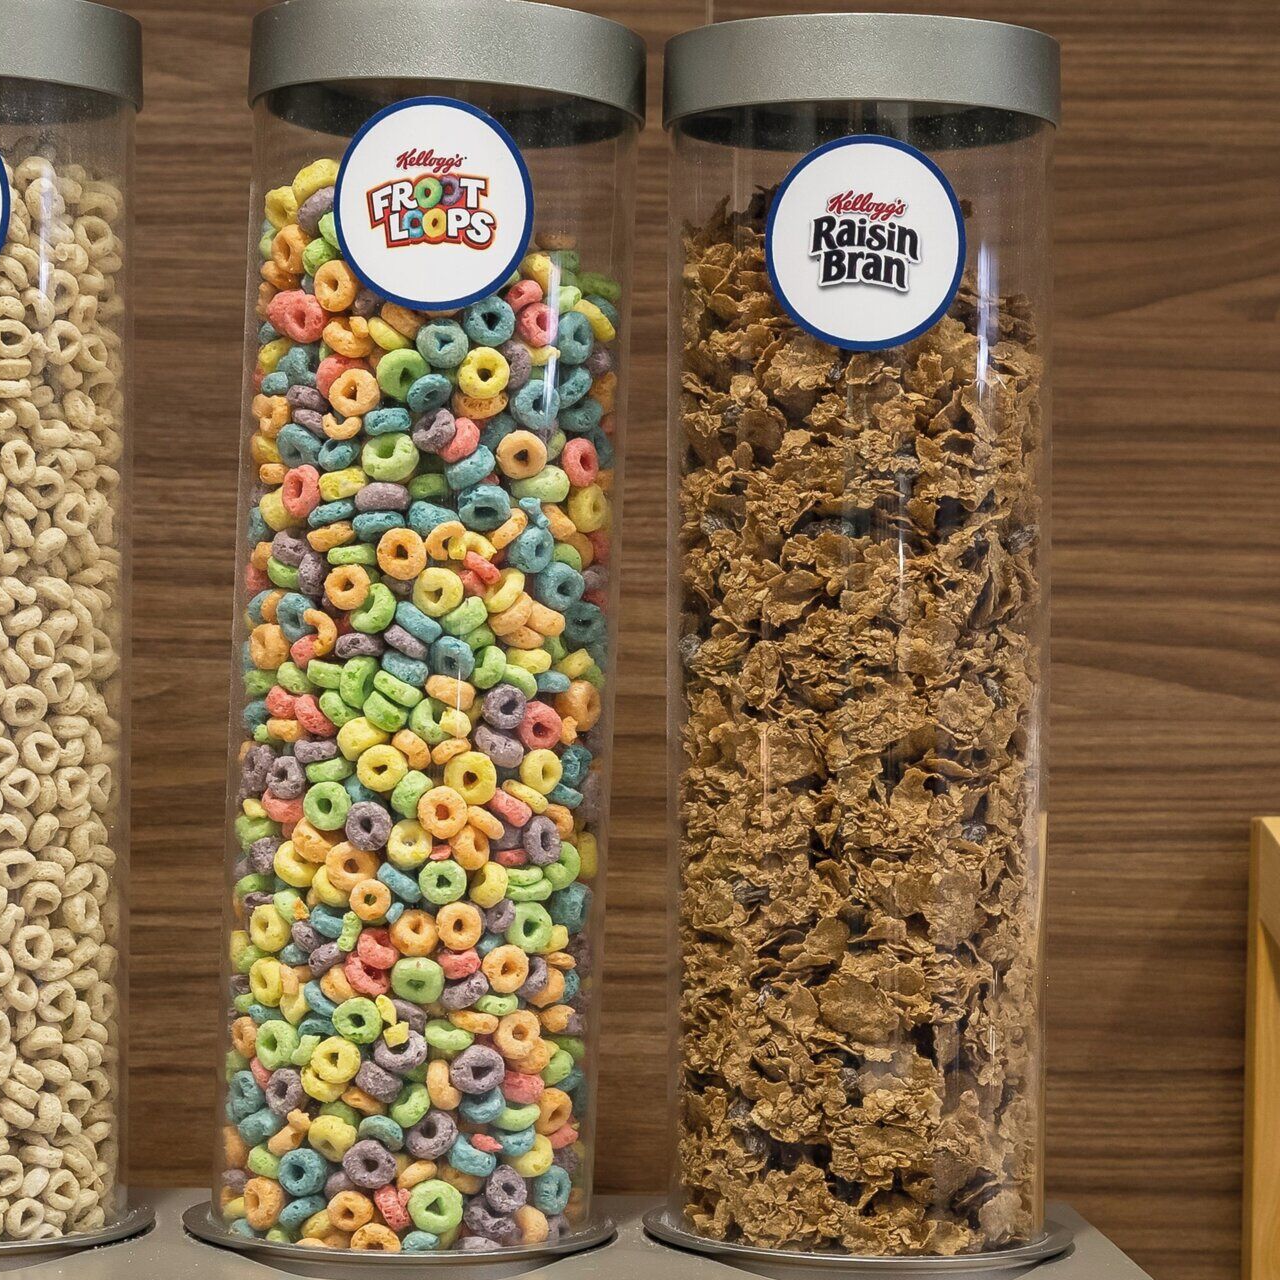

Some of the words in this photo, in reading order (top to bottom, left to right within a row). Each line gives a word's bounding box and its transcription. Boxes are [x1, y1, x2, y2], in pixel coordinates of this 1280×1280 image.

[396, 148, 463, 173] Kellogg's
[371, 175, 487, 221] FROOT
[828, 190, 907, 221] Kellogg's
[388, 207, 495, 244] LOOPS
[811, 215, 919, 261] Raisin
[821, 249, 907, 289] Bran
